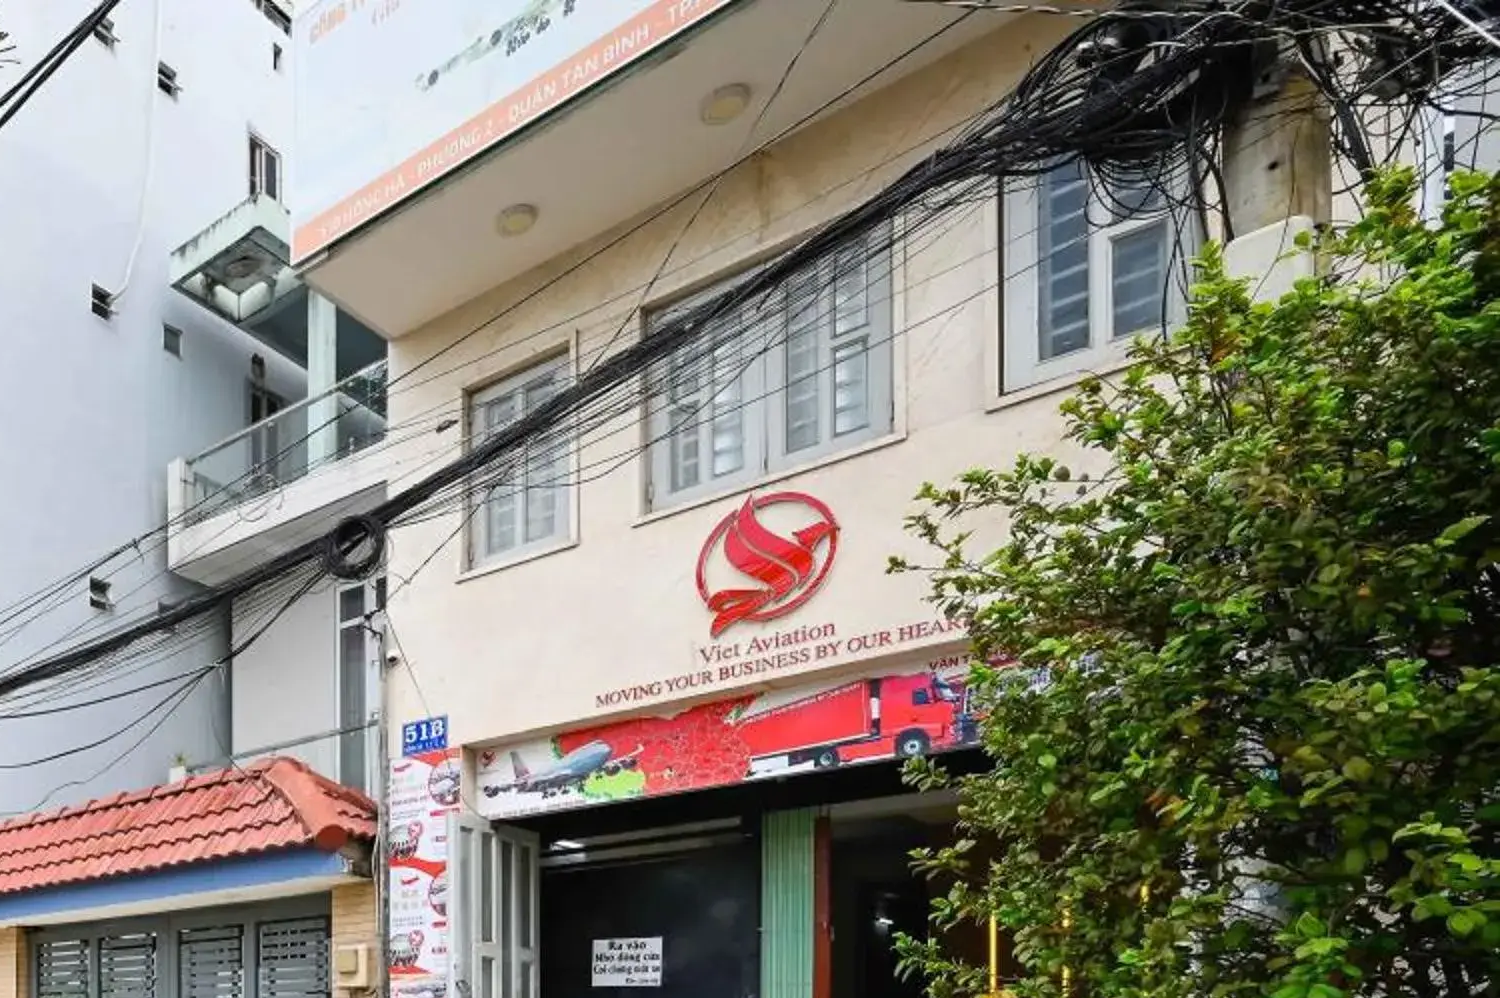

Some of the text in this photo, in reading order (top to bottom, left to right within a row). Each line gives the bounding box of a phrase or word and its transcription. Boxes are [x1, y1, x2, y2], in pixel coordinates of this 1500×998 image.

[700, 623, 836, 664] Viet Aviation
[596, 681, 661, 708] MOVING
[665, 669, 713, 692] YOUR
[719, 650, 810, 681] BUSINESS
[815, 640, 841, 659] BY
[847, 631, 893, 651] OUR
[405, 719, 445, 743] 51B
